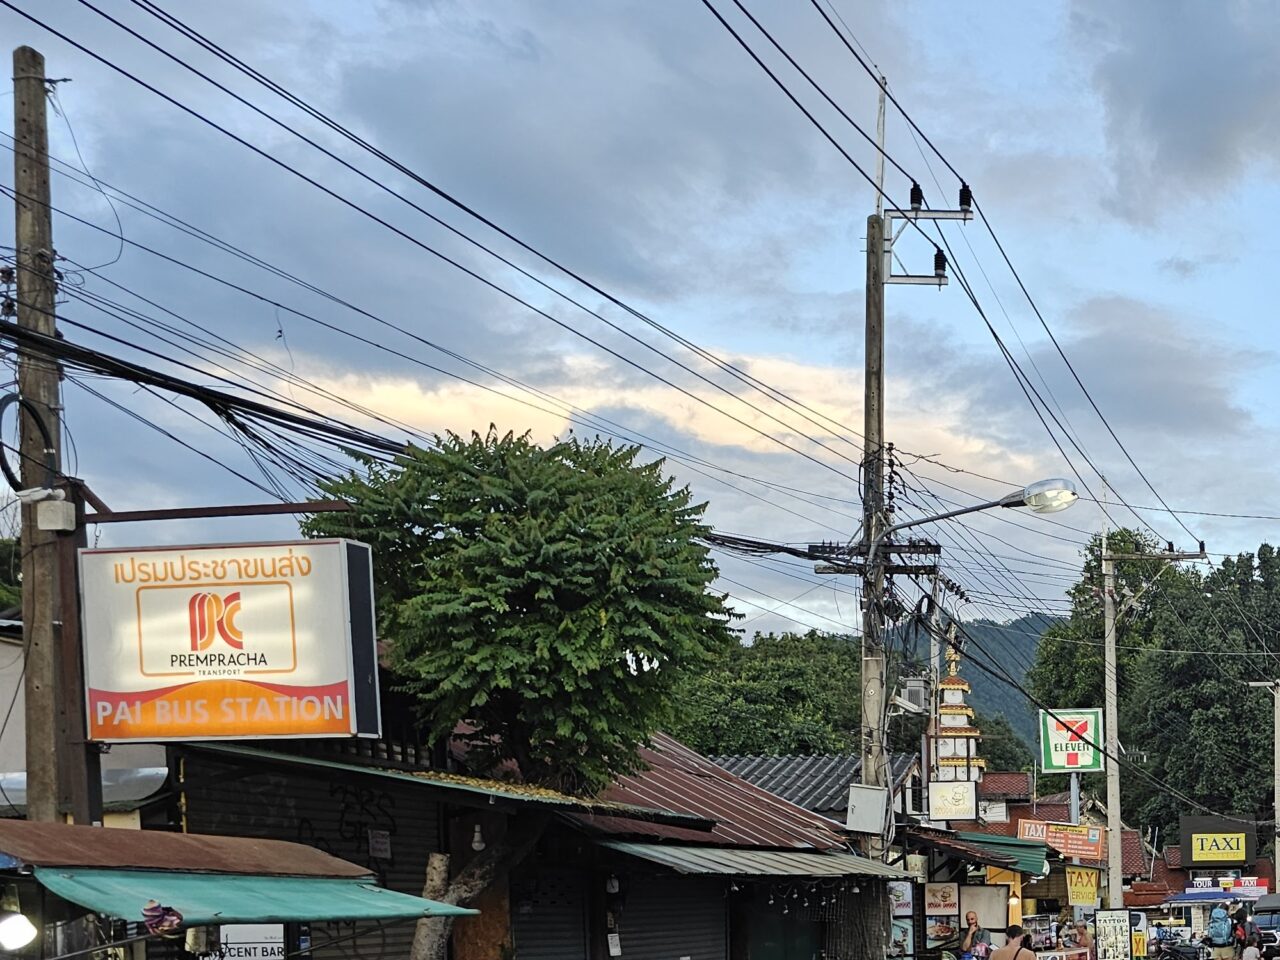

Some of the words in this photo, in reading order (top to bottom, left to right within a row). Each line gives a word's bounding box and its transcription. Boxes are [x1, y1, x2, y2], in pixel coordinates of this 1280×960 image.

[114, 549, 312, 584] เปรมประชาขนส่ง
[170, 653, 267, 668] PREMPRACHA
[96, 700, 141, 726] PAI
[155, 698, 209, 725] BUS
[220, 695, 344, 723] STATION
[1055, 720, 1088, 742] 7
[1023, 823, 1047, 837] TAXI
[1197, 837, 1241, 851] TAXI
[1067, 871, 1098, 888] TAXI
[1192, 880, 1212, 888] TOUR
[1071, 890, 1096, 901] ERVICE
[228, 946, 258, 958] CENT
[261, 946, 285, 957] BAR
[1134, 937, 1146, 955] XI
